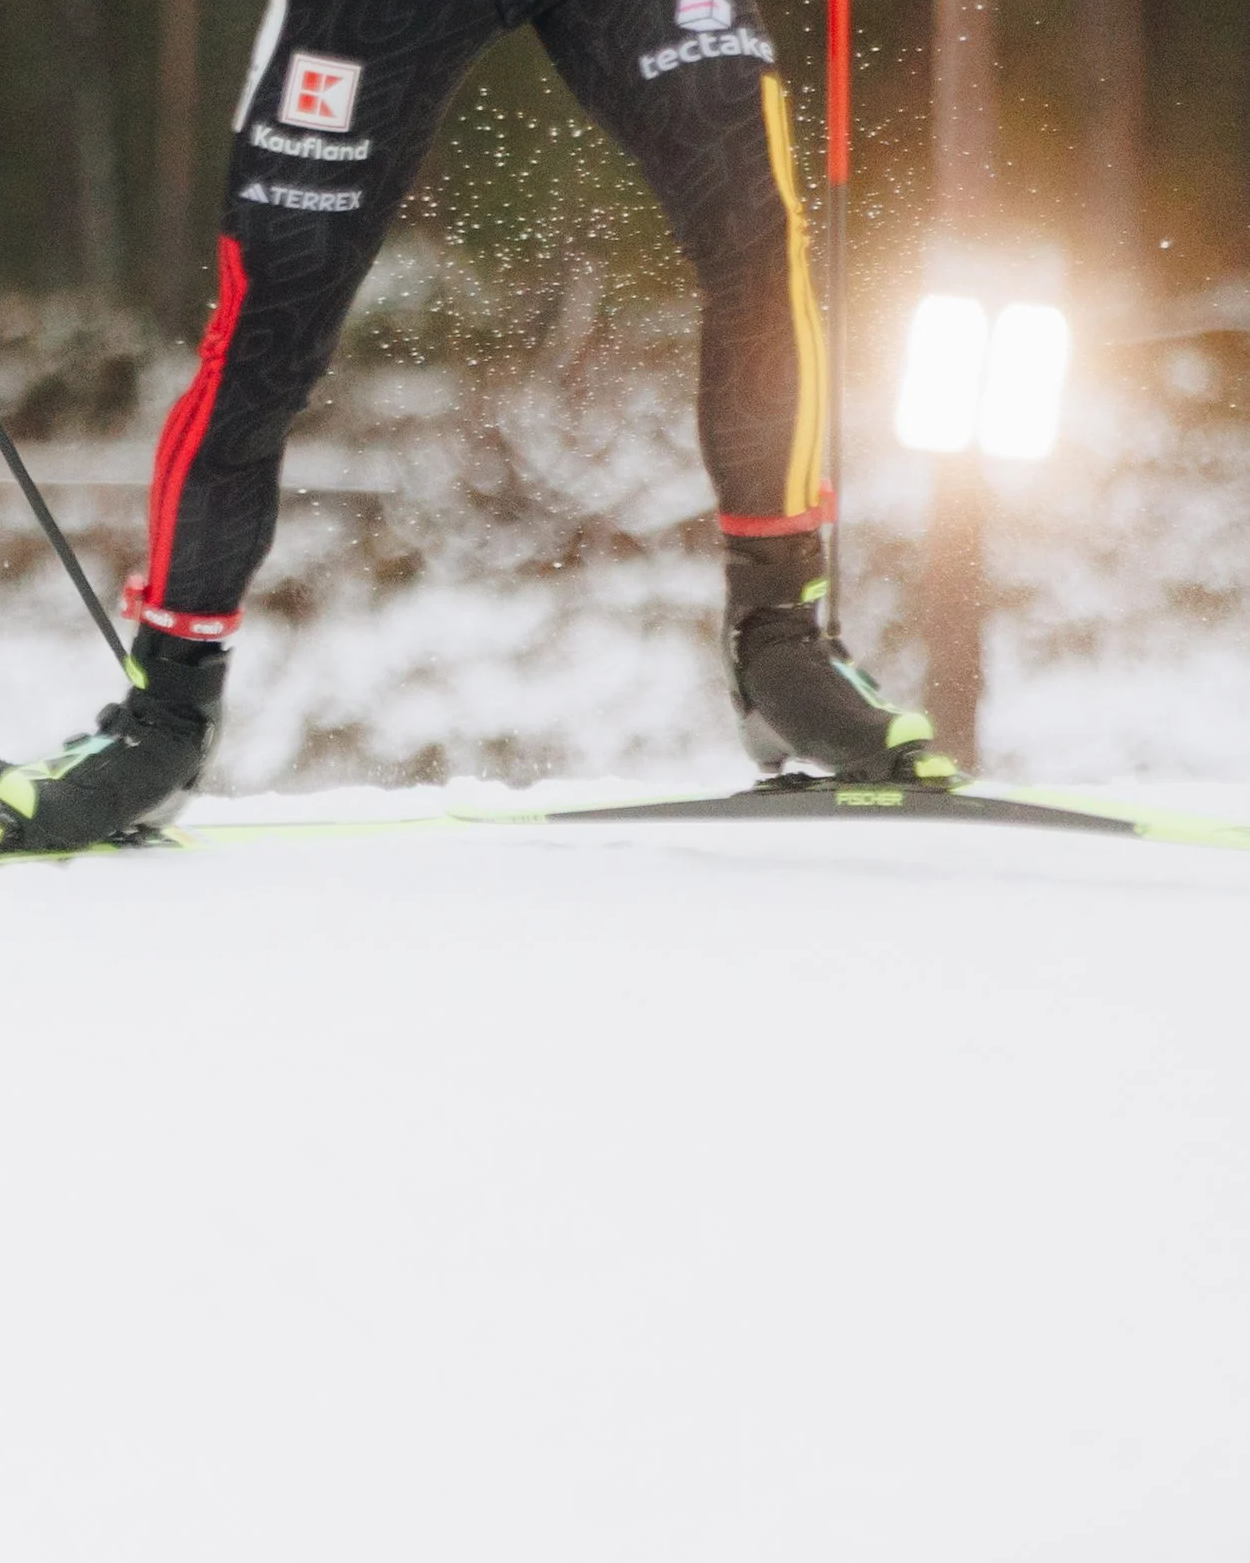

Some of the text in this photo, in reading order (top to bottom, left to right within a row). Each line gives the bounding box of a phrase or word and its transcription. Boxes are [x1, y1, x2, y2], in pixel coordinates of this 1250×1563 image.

[639, 28, 775, 80] tectake
[254, 124, 371, 161] Kaufland
[271, 187, 363, 212] TERREX
[837, 792, 903, 806] FISCHER
